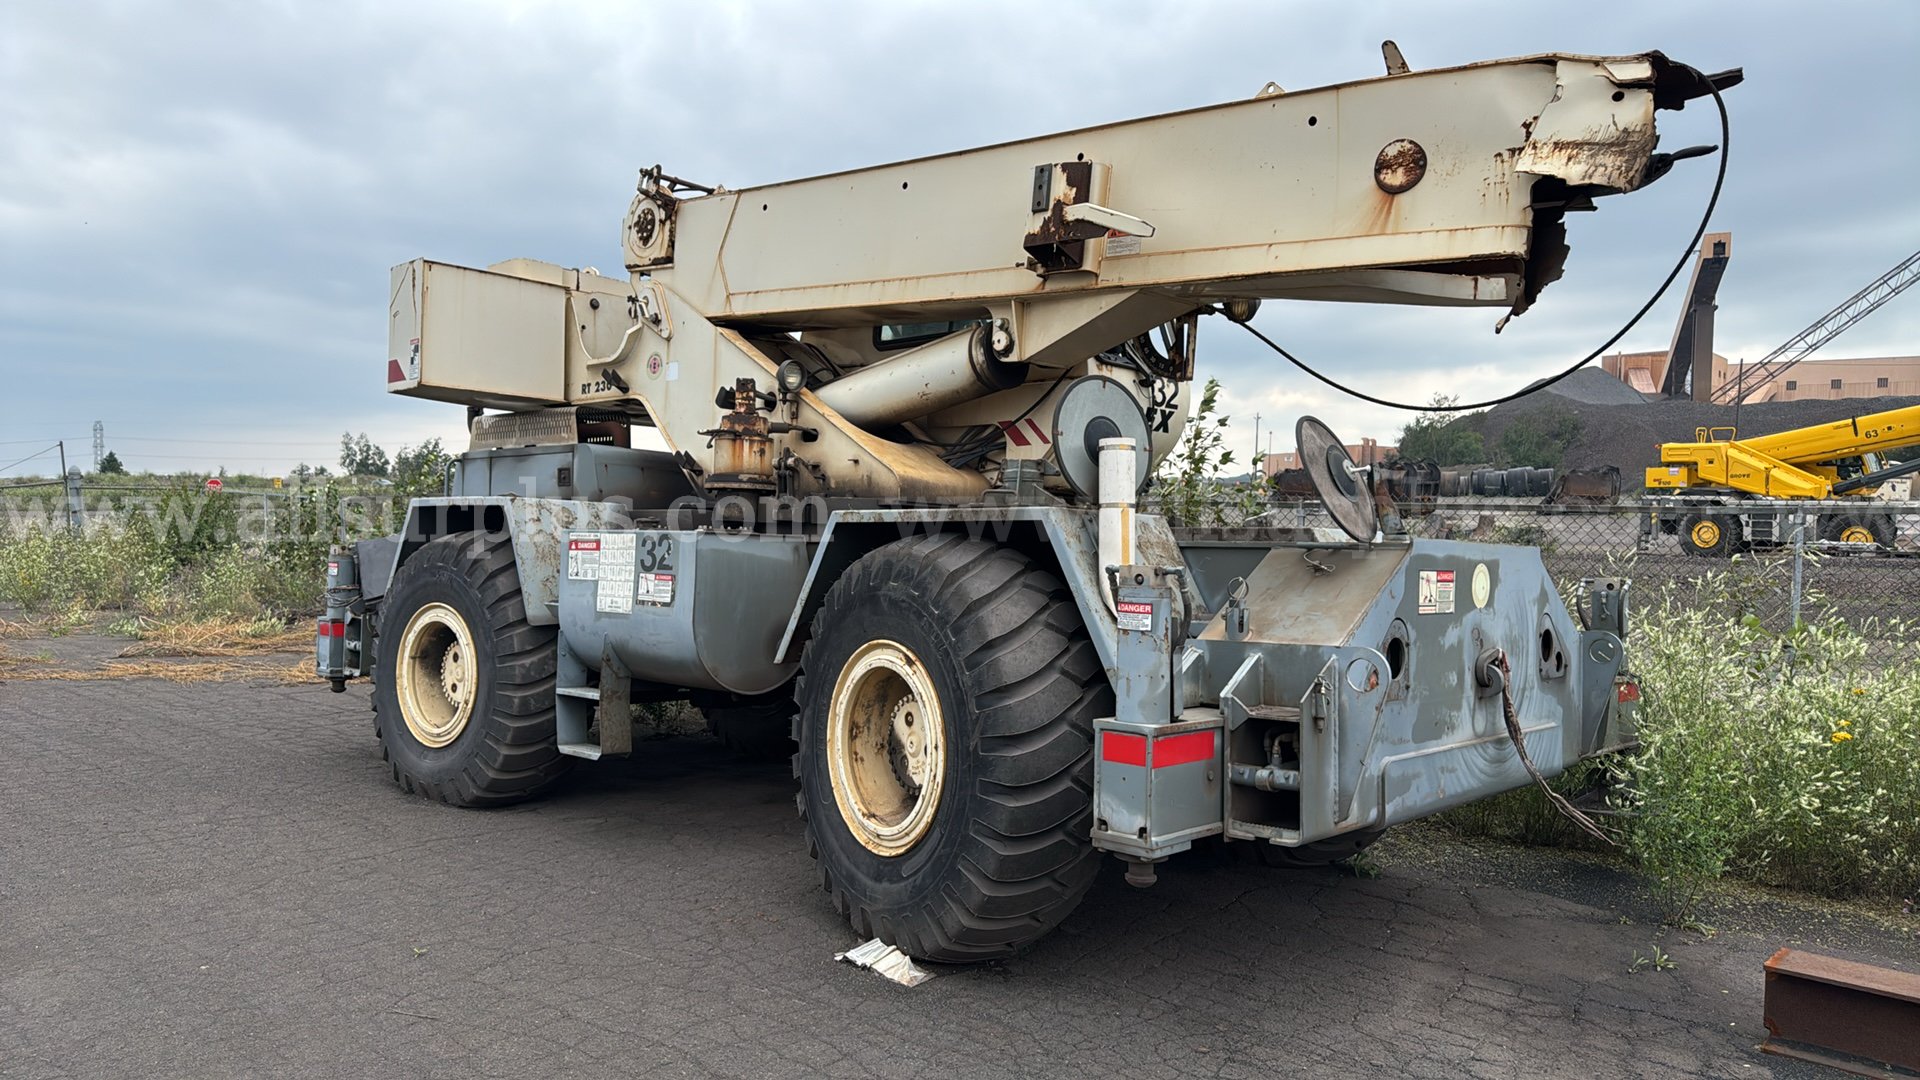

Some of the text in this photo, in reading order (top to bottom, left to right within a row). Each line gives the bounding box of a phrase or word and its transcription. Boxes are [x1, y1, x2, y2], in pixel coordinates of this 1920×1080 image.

[581, 381, 612, 394] RT 230
[1152, 377, 1179, 410] 32
[1865, 429, 1879, 438] 63
[577, 541, 597, 549] DANGER
[640, 534, 673, 571] 32
[1121, 603, 1151, 613] DANGER
